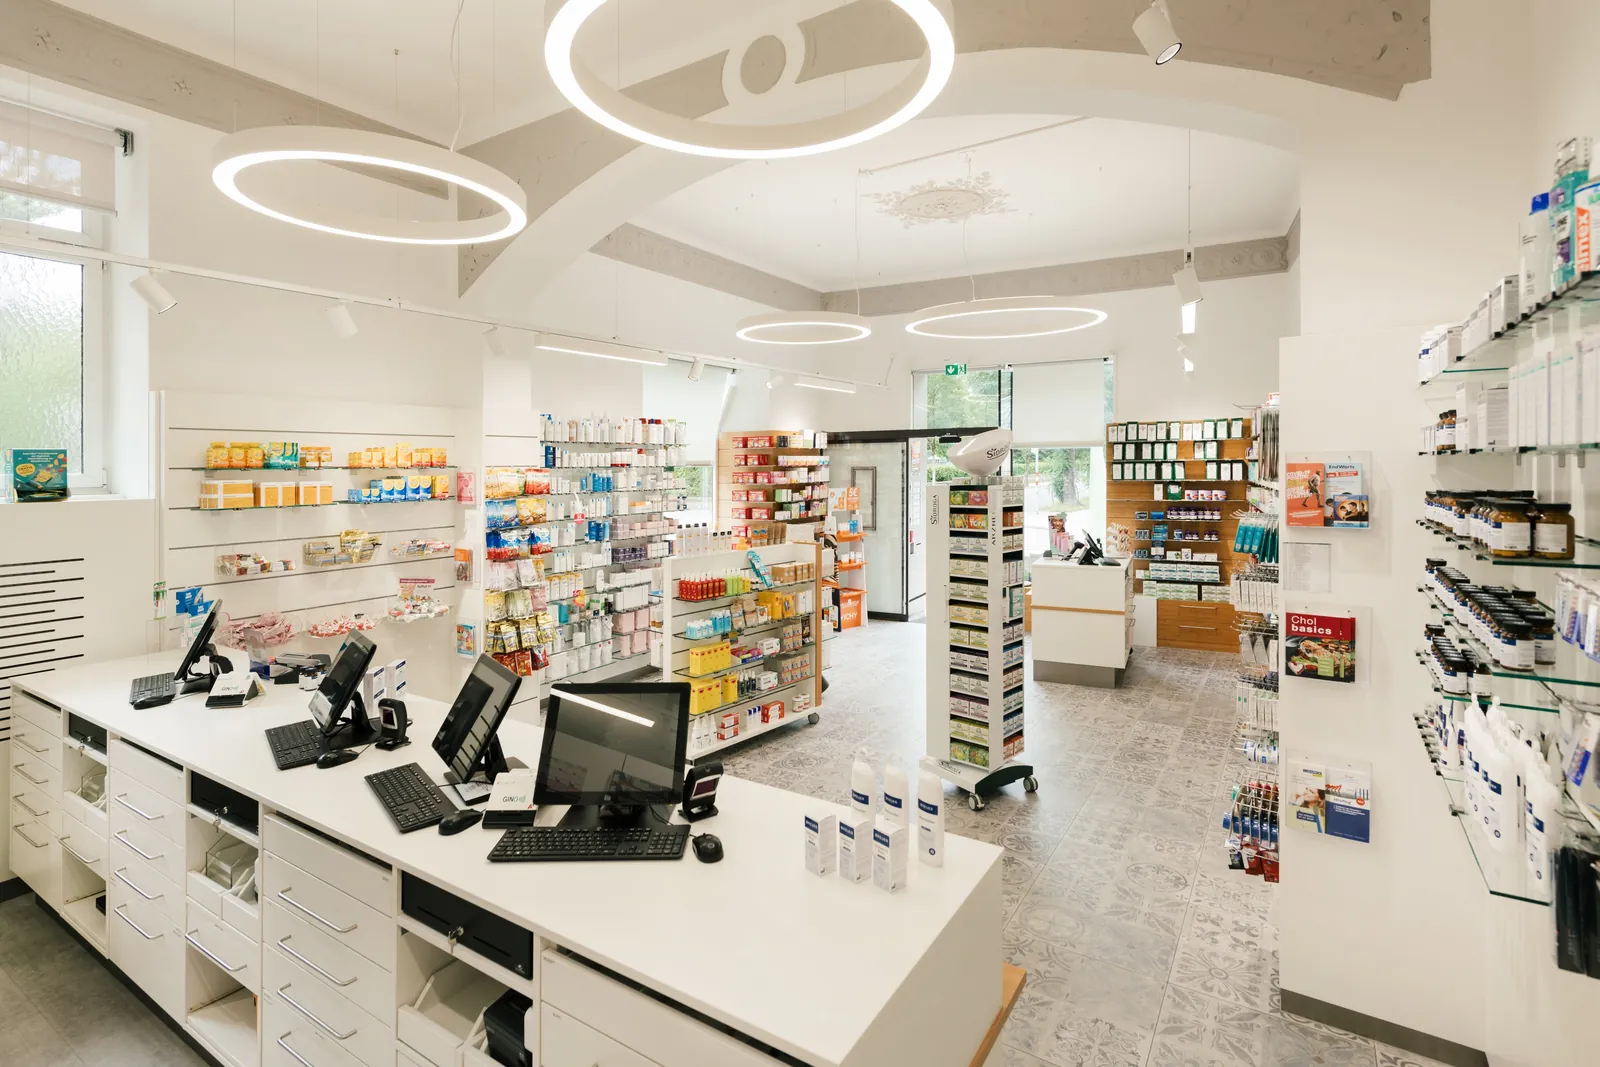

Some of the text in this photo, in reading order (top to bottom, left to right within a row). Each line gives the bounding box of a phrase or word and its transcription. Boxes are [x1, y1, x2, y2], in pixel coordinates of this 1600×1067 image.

[1576, 212, 1589, 272] elmex
[1291, 615, 1317, 625] Chol
[1291, 624, 1332, 635] basics
